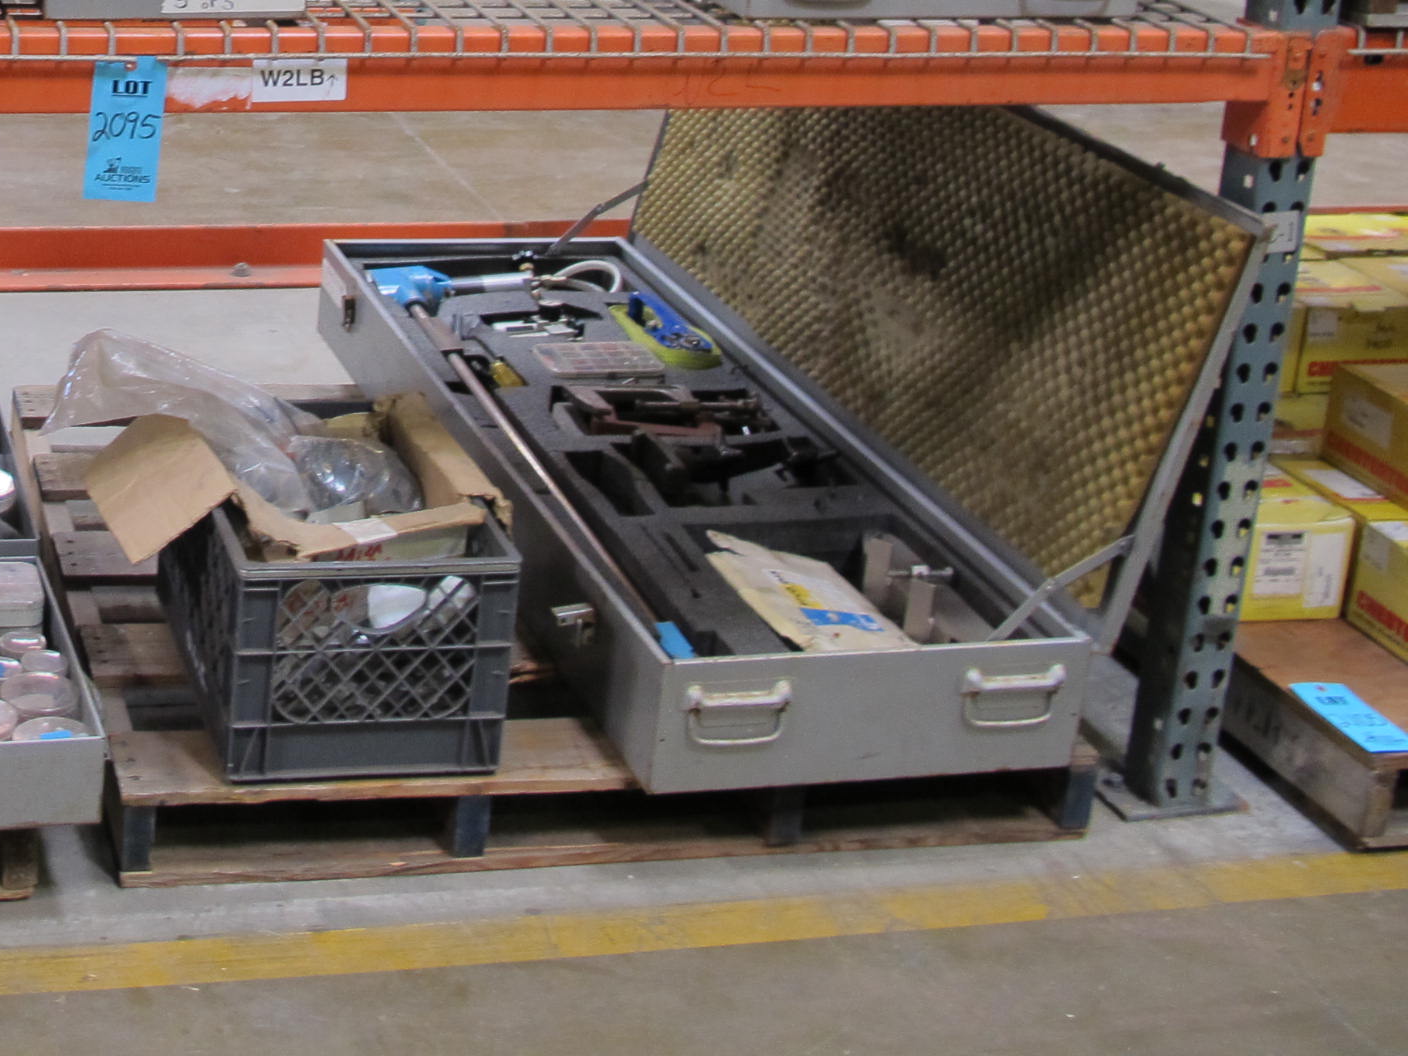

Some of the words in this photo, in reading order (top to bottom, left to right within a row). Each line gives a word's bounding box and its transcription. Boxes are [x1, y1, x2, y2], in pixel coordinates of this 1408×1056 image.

[260, 69, 325, 87] W2LB
[112, 80, 153, 94] LOT
[92, 111, 162, 142] 2095
[94, 173, 152, 184] AUCTIONS
